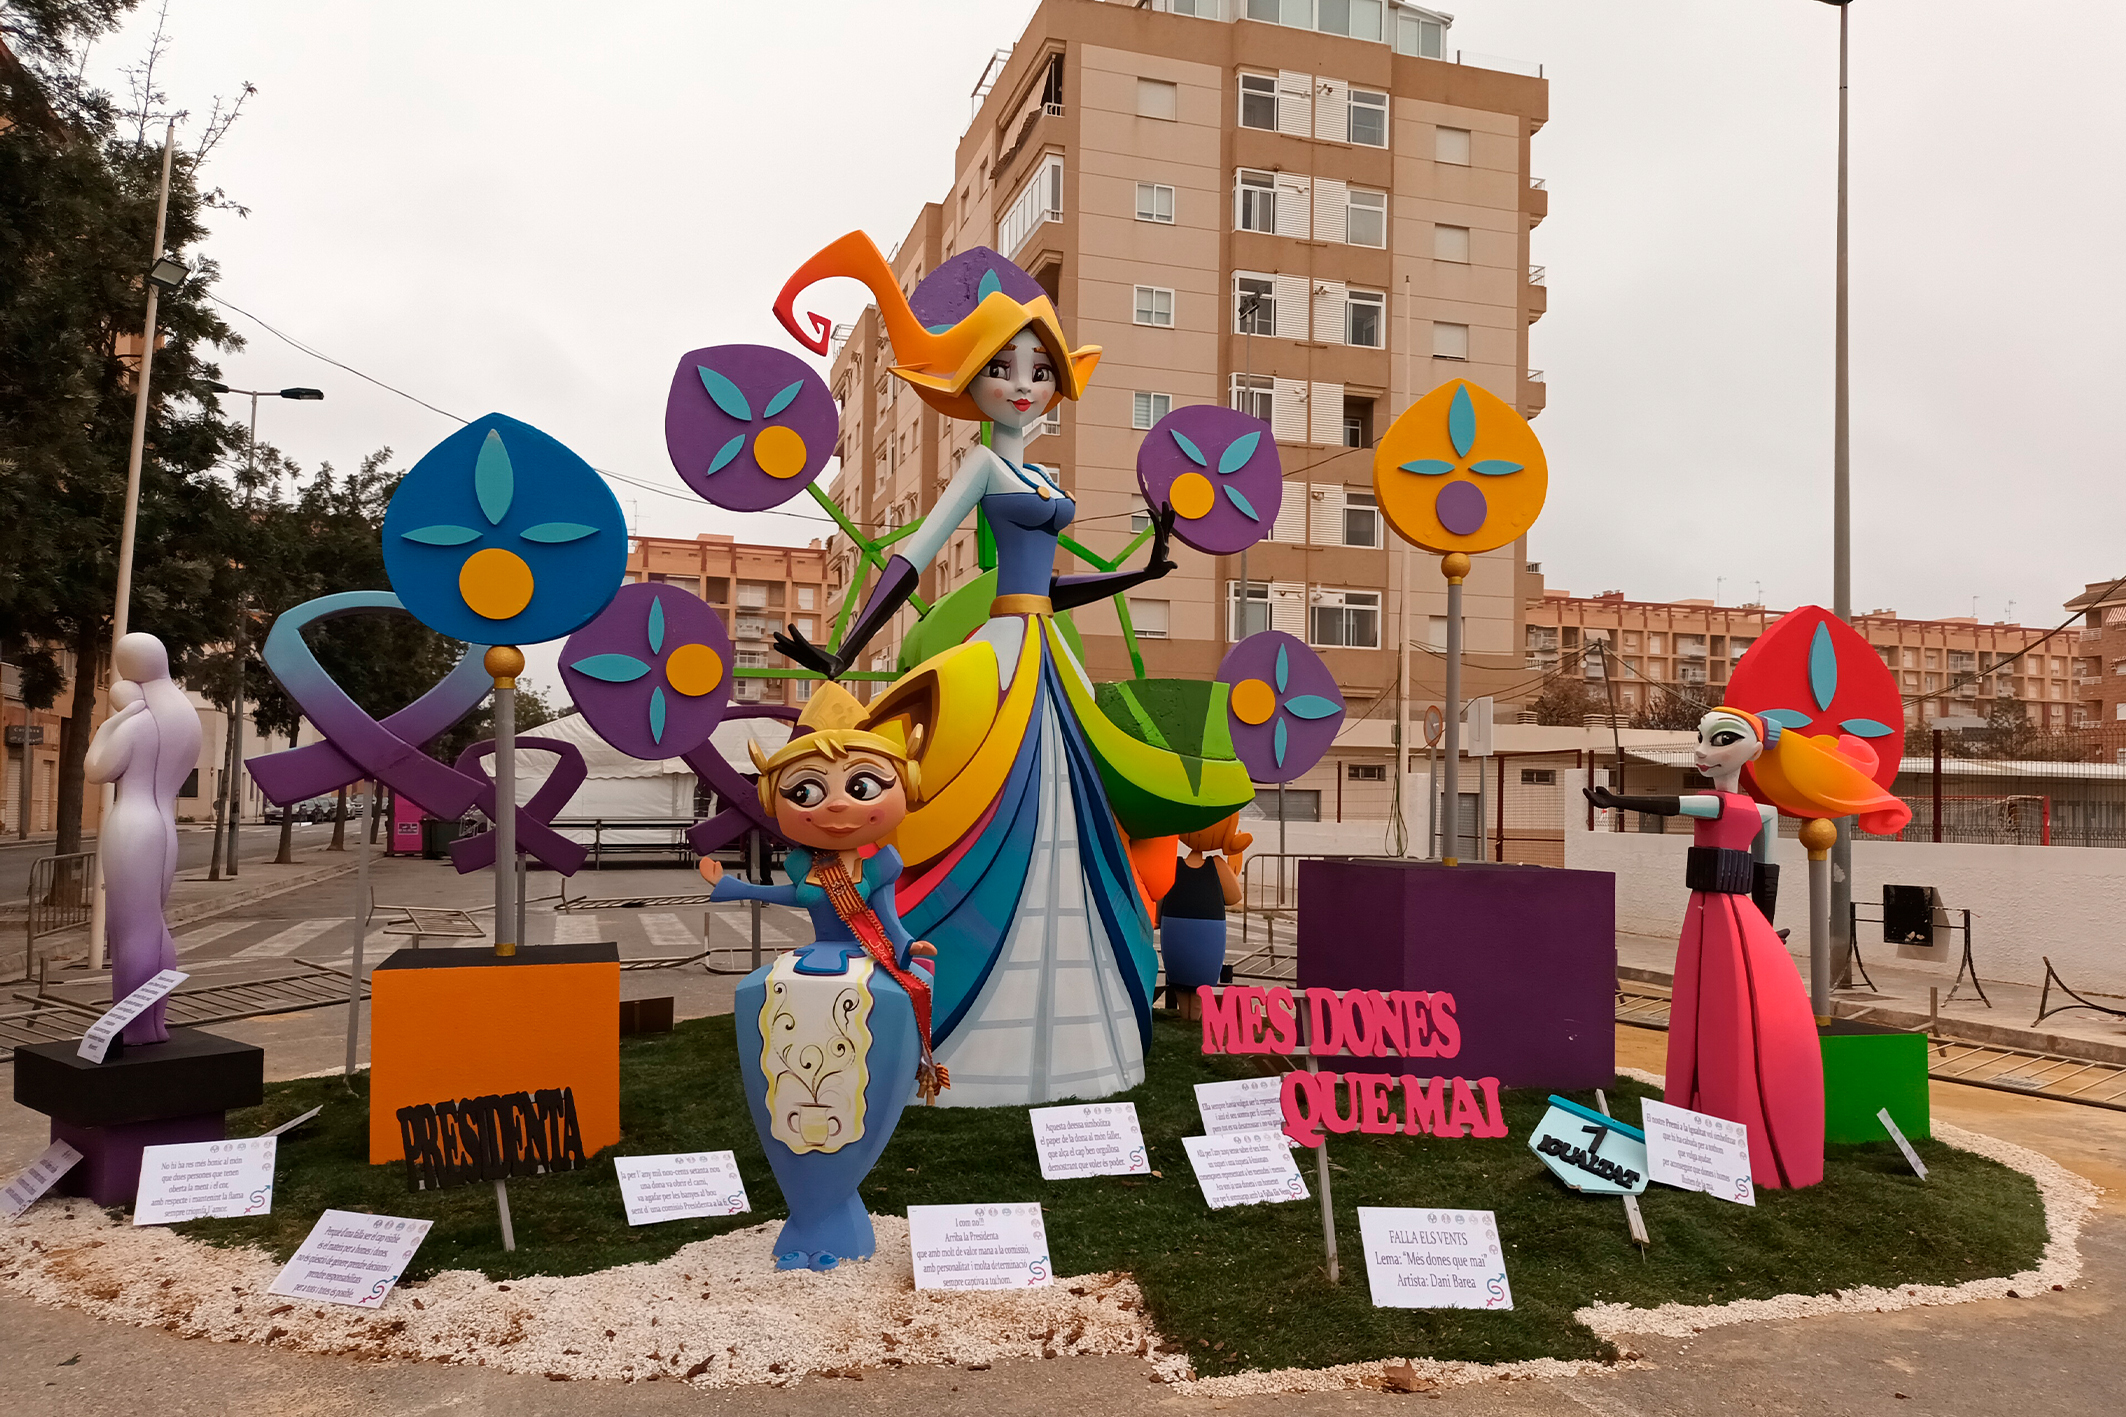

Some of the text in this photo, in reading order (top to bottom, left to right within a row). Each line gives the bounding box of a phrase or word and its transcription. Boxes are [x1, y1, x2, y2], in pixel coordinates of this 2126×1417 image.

[1197, 985, 1461, 1059] MES DONES
[1280, 1070, 1509, 1148] QUE MAI
[396, 1086, 587, 1193] PRESIDENTA
[161, 1162, 170, 1170] No
[1537, 1134, 1641, 1190] IGUALTAT
[969, 1231, 999, 1241] Presidenta
[1389, 1230, 1468, 1246] FALLA ELS VENTS
[1375, 1251, 1402, 1265] Lema:
[1425, 1252, 1452, 1266] dones
[1452, 1256, 1468, 1270] que
[1397, 1273, 1476, 1288] Artista: Dani Barea
